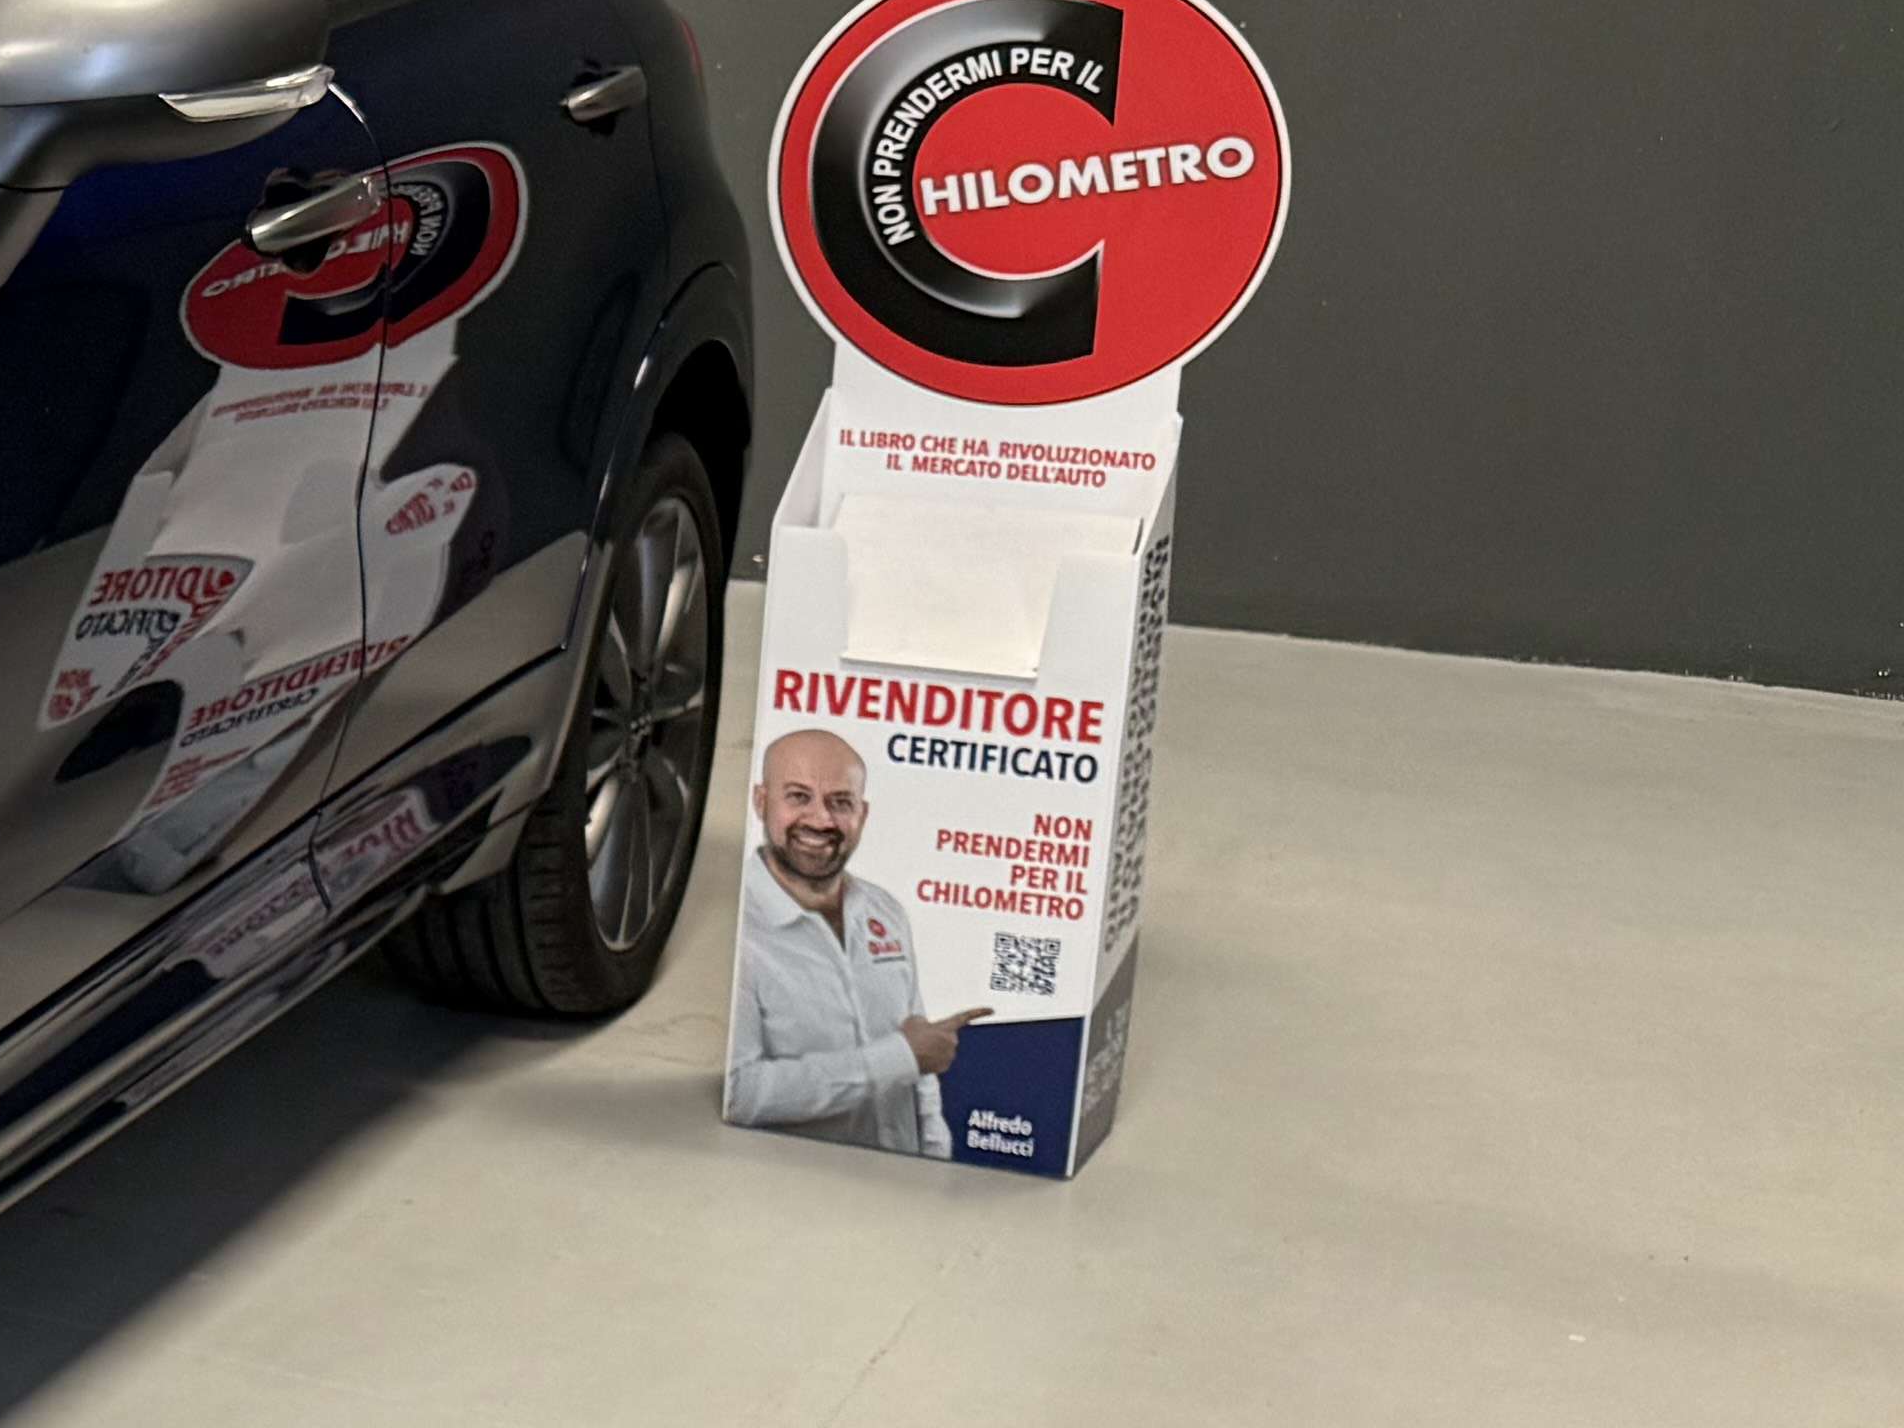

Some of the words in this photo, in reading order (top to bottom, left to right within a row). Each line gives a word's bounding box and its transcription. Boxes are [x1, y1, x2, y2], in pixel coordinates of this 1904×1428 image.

[1010, 47, 1074, 80] PER
[1076, 60, 1104, 94] IL
[872, 50, 1003, 178] PRENDERMI
[872, 184, 915, 246] NON
[839, 428, 856, 448] IL
[860, 431, 915, 452] LIBRO
[920, 435, 957, 456] CHE
[962, 439, 989, 458] HA
[998, 441, 1156, 471] RIVOLUZIONATO
[886, 454, 902, 471] IL
[911, 456, 1001, 479] MERCATO
[1006, 463, 1106, 488] DELL'AUTO
[774, 669, 1105, 745] RIVENDITORE
[887, 733, 1099, 784] CERTIFICATO
[1034, 813, 1093, 842] NON
[936, 828, 1090, 868] PRENDERMI
[916, 879, 1085, 921] CHILOMETRO
[1010, 864, 1059, 892] PER
[1066, 870, 1088, 896] IL
[968, 1109, 1033, 1136] Alfredo
